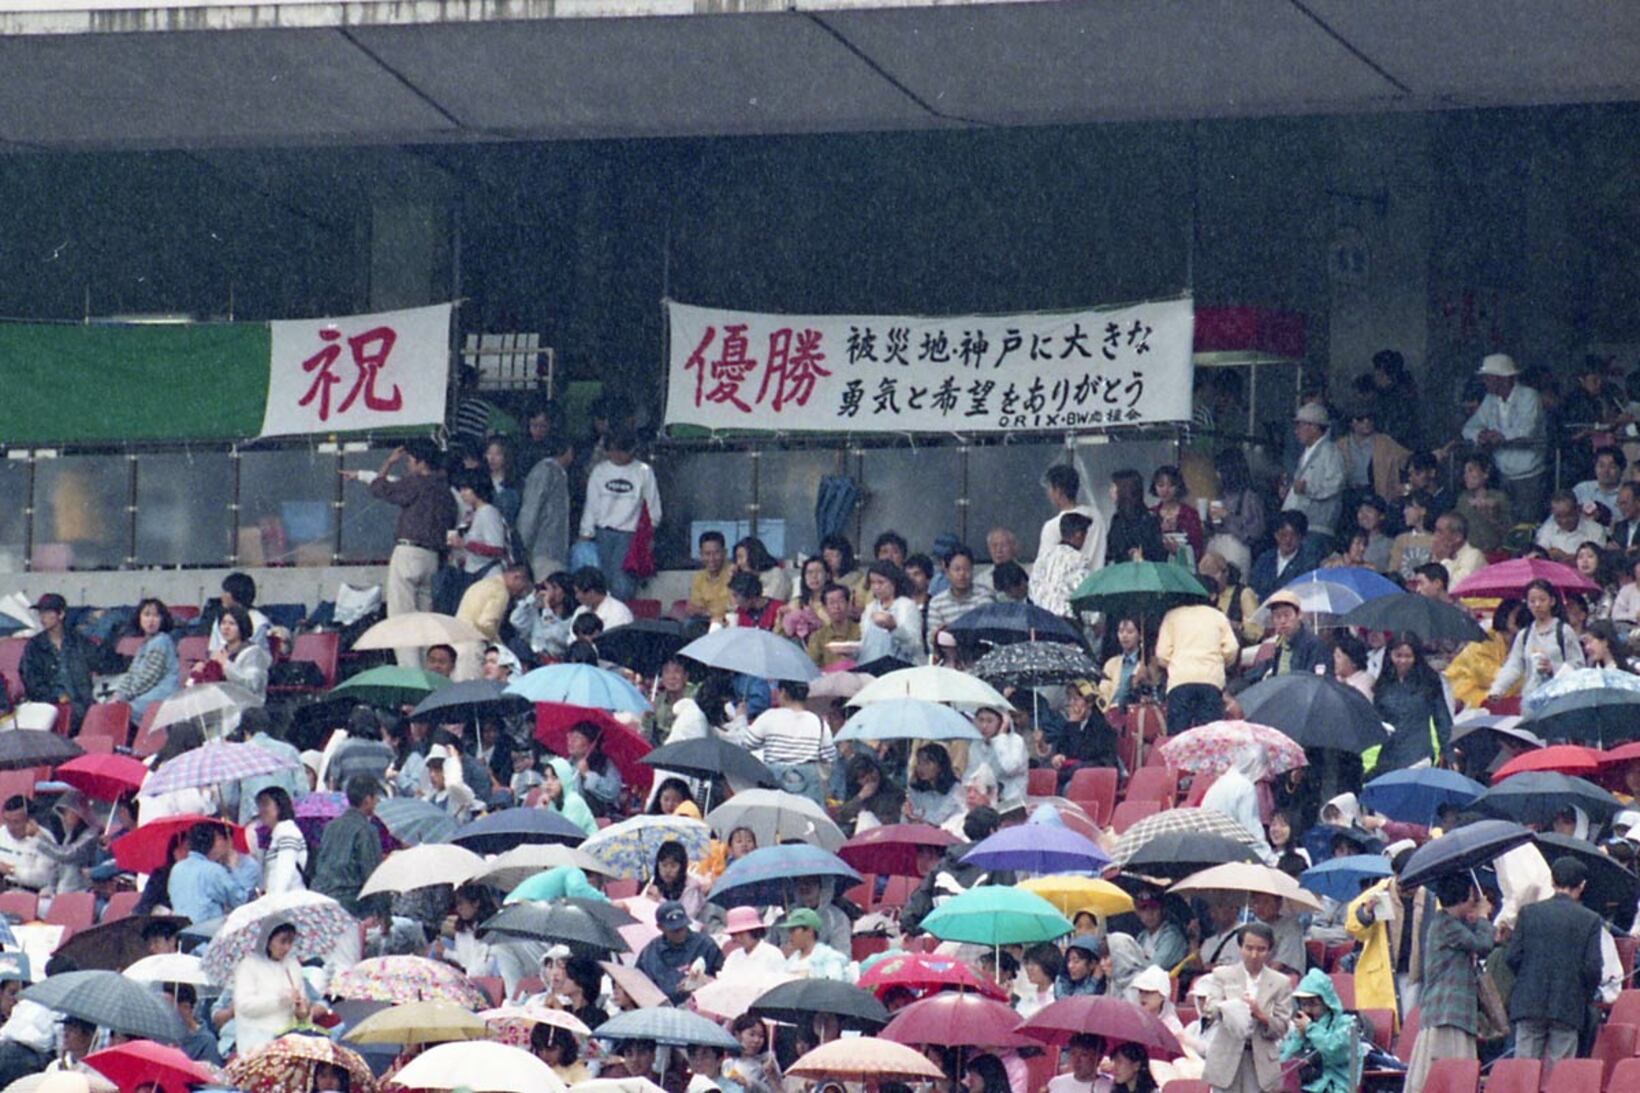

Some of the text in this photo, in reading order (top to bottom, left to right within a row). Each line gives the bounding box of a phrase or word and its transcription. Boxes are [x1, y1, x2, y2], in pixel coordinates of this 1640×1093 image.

[299, 326, 403, 421] 祝
[684, 325, 832, 413] 優勝
[836, 371, 1146, 416] 勇気と希望をありがとう
